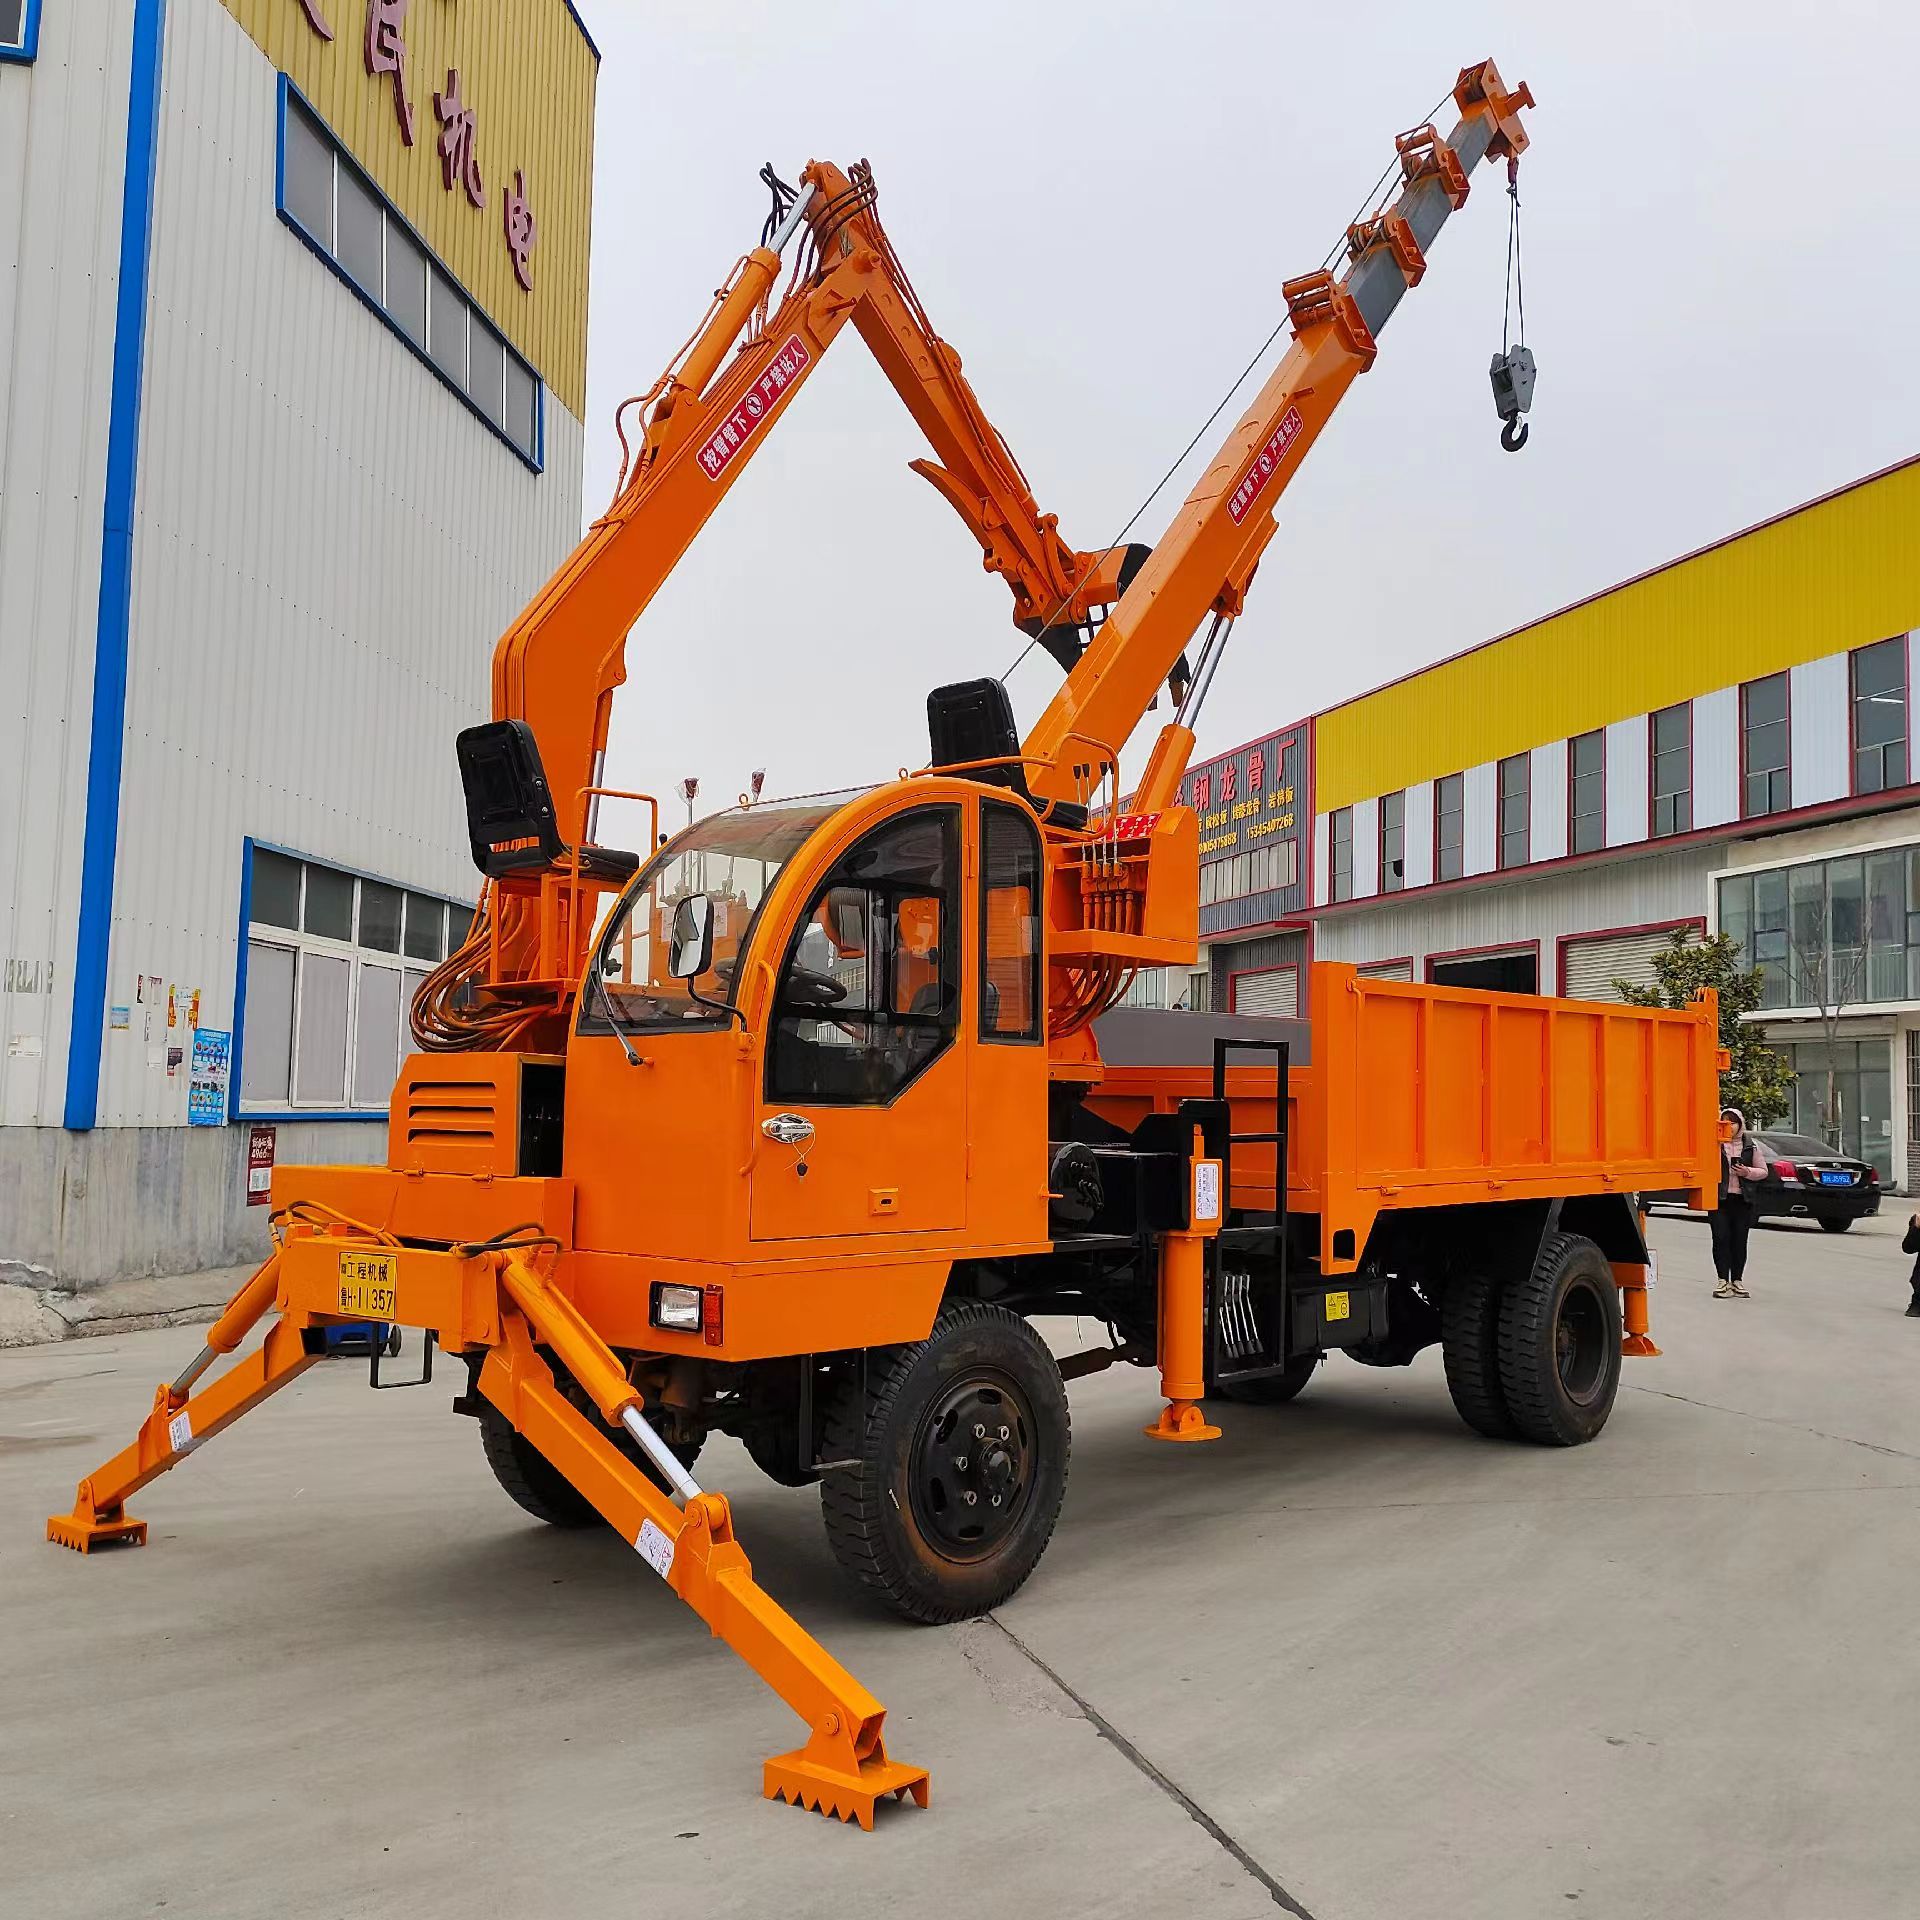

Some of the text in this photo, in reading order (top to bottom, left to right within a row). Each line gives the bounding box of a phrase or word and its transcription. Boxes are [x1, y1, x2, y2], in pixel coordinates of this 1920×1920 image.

[760, 345, 805, 400] 严禁站人
[1230, 468, 1259, 517] 起重臂下
[1269, 411, 1299, 457] 严禁站人
[347, 1262, 388, 1282] 工程机械
